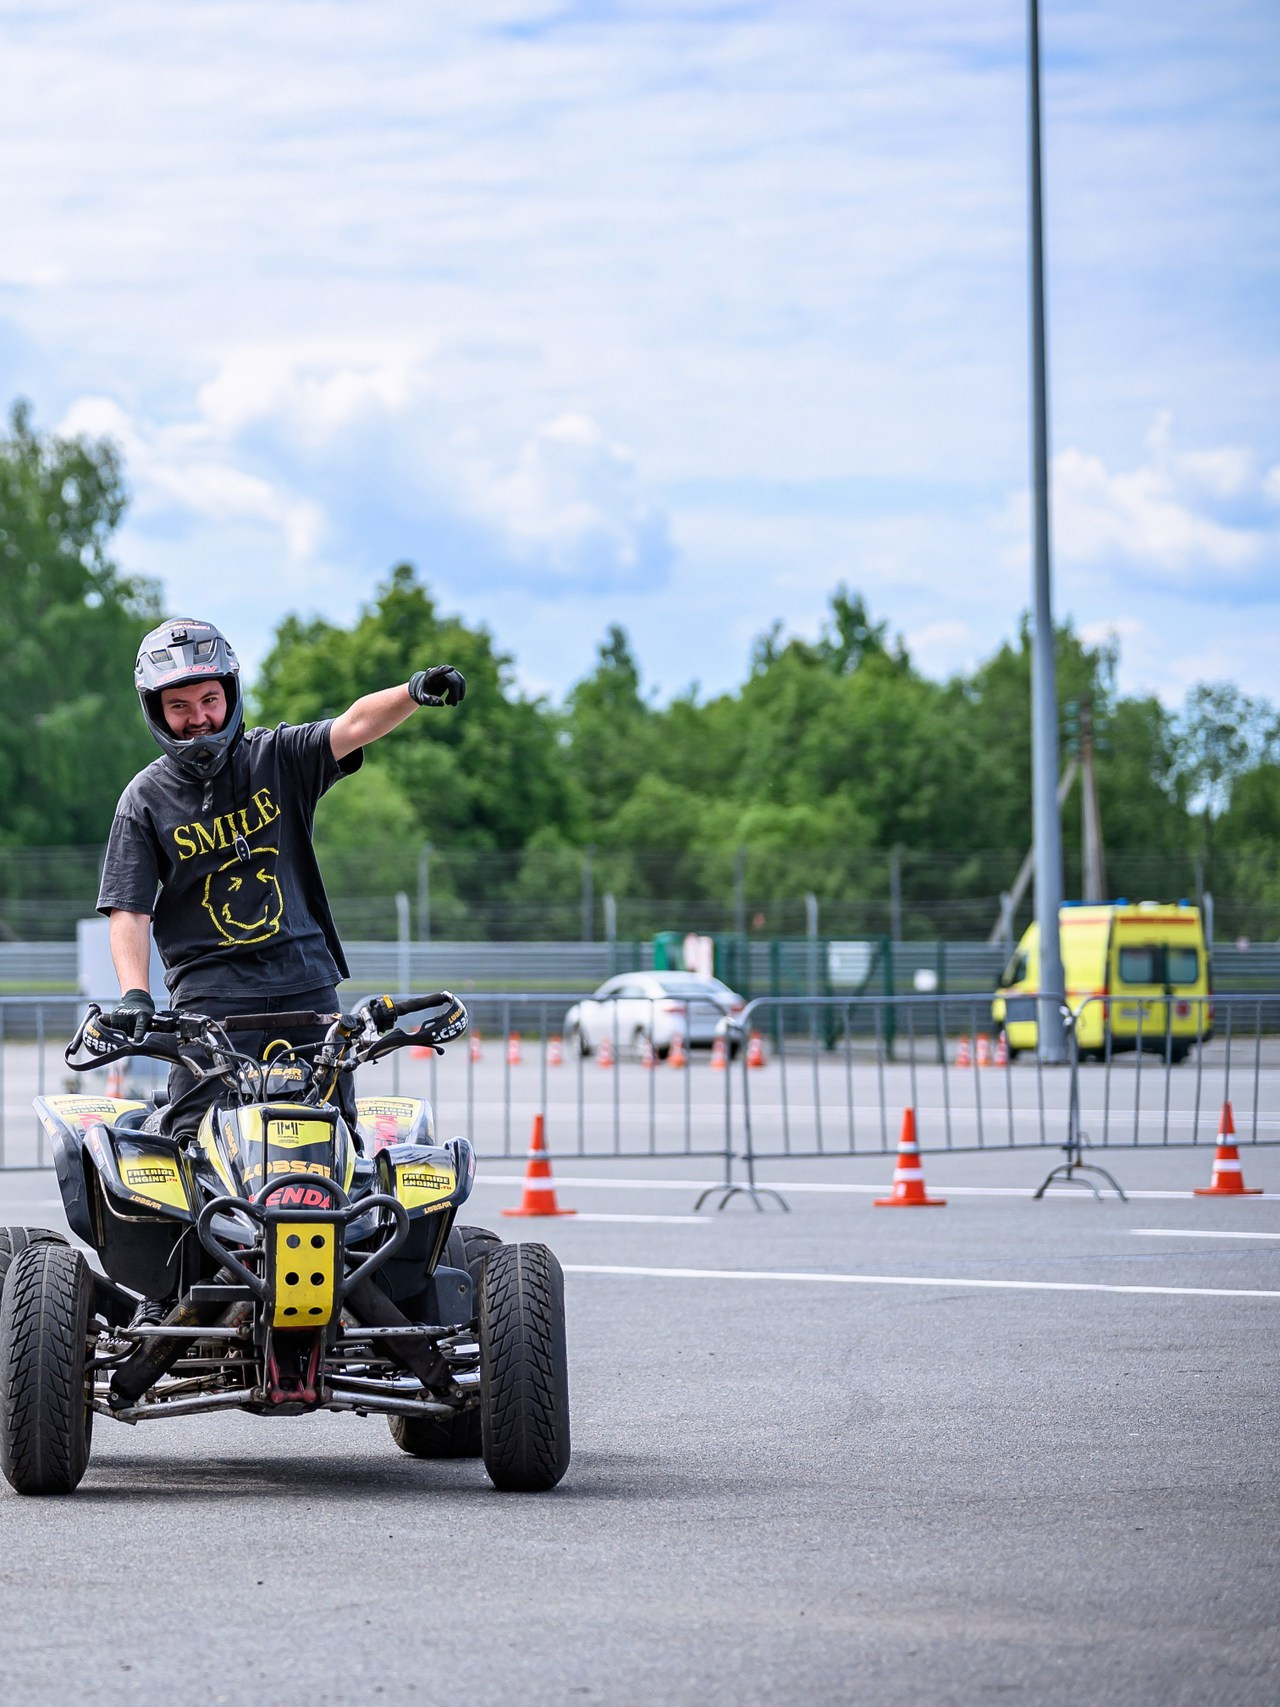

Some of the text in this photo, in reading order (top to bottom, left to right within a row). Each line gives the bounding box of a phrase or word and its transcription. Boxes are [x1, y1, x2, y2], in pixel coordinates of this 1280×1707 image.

[173, 788, 281, 860] SMILE
[127, 1168, 175, 1178] FREERIDE
[402, 1173, 450, 1185] FREERIDE
